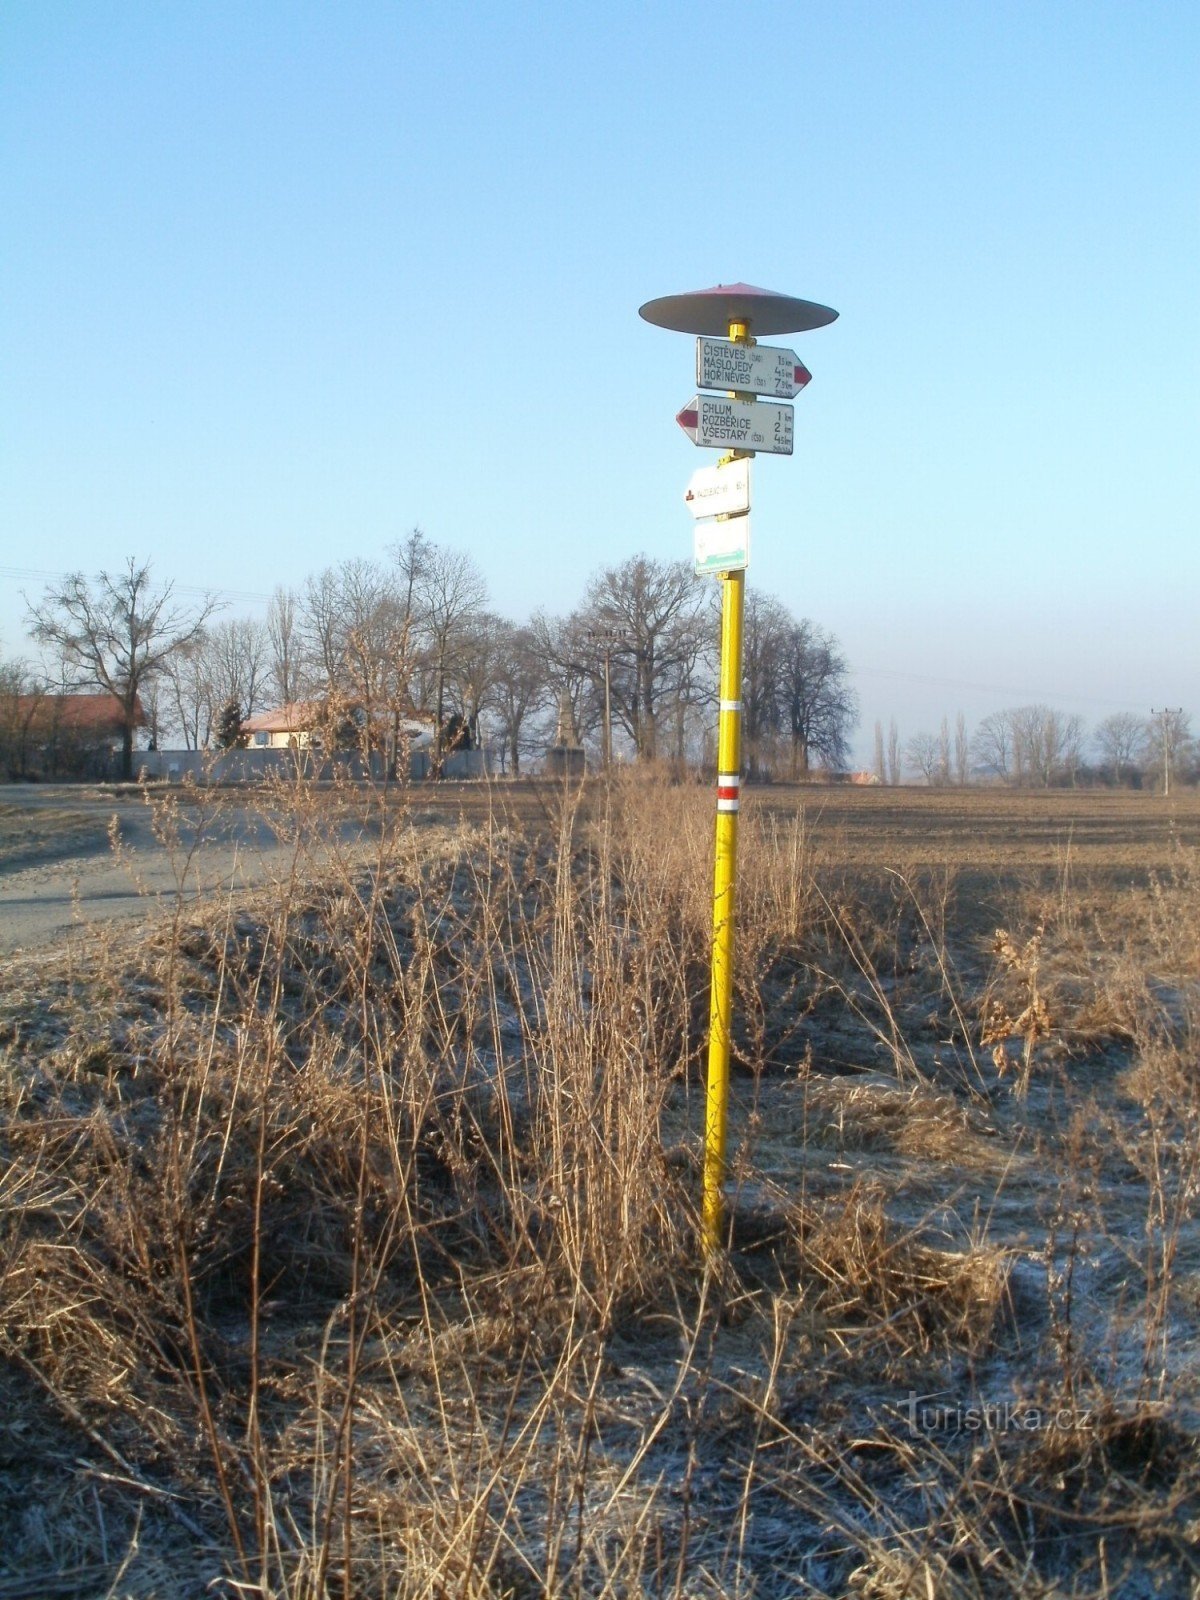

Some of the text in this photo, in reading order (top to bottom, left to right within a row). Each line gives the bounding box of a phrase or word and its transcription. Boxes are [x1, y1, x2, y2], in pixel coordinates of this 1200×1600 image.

[702, 402, 732, 415] CHLUM
[702, 424, 748, 440] VŠESTARY
[774, 422, 781, 432] 2
